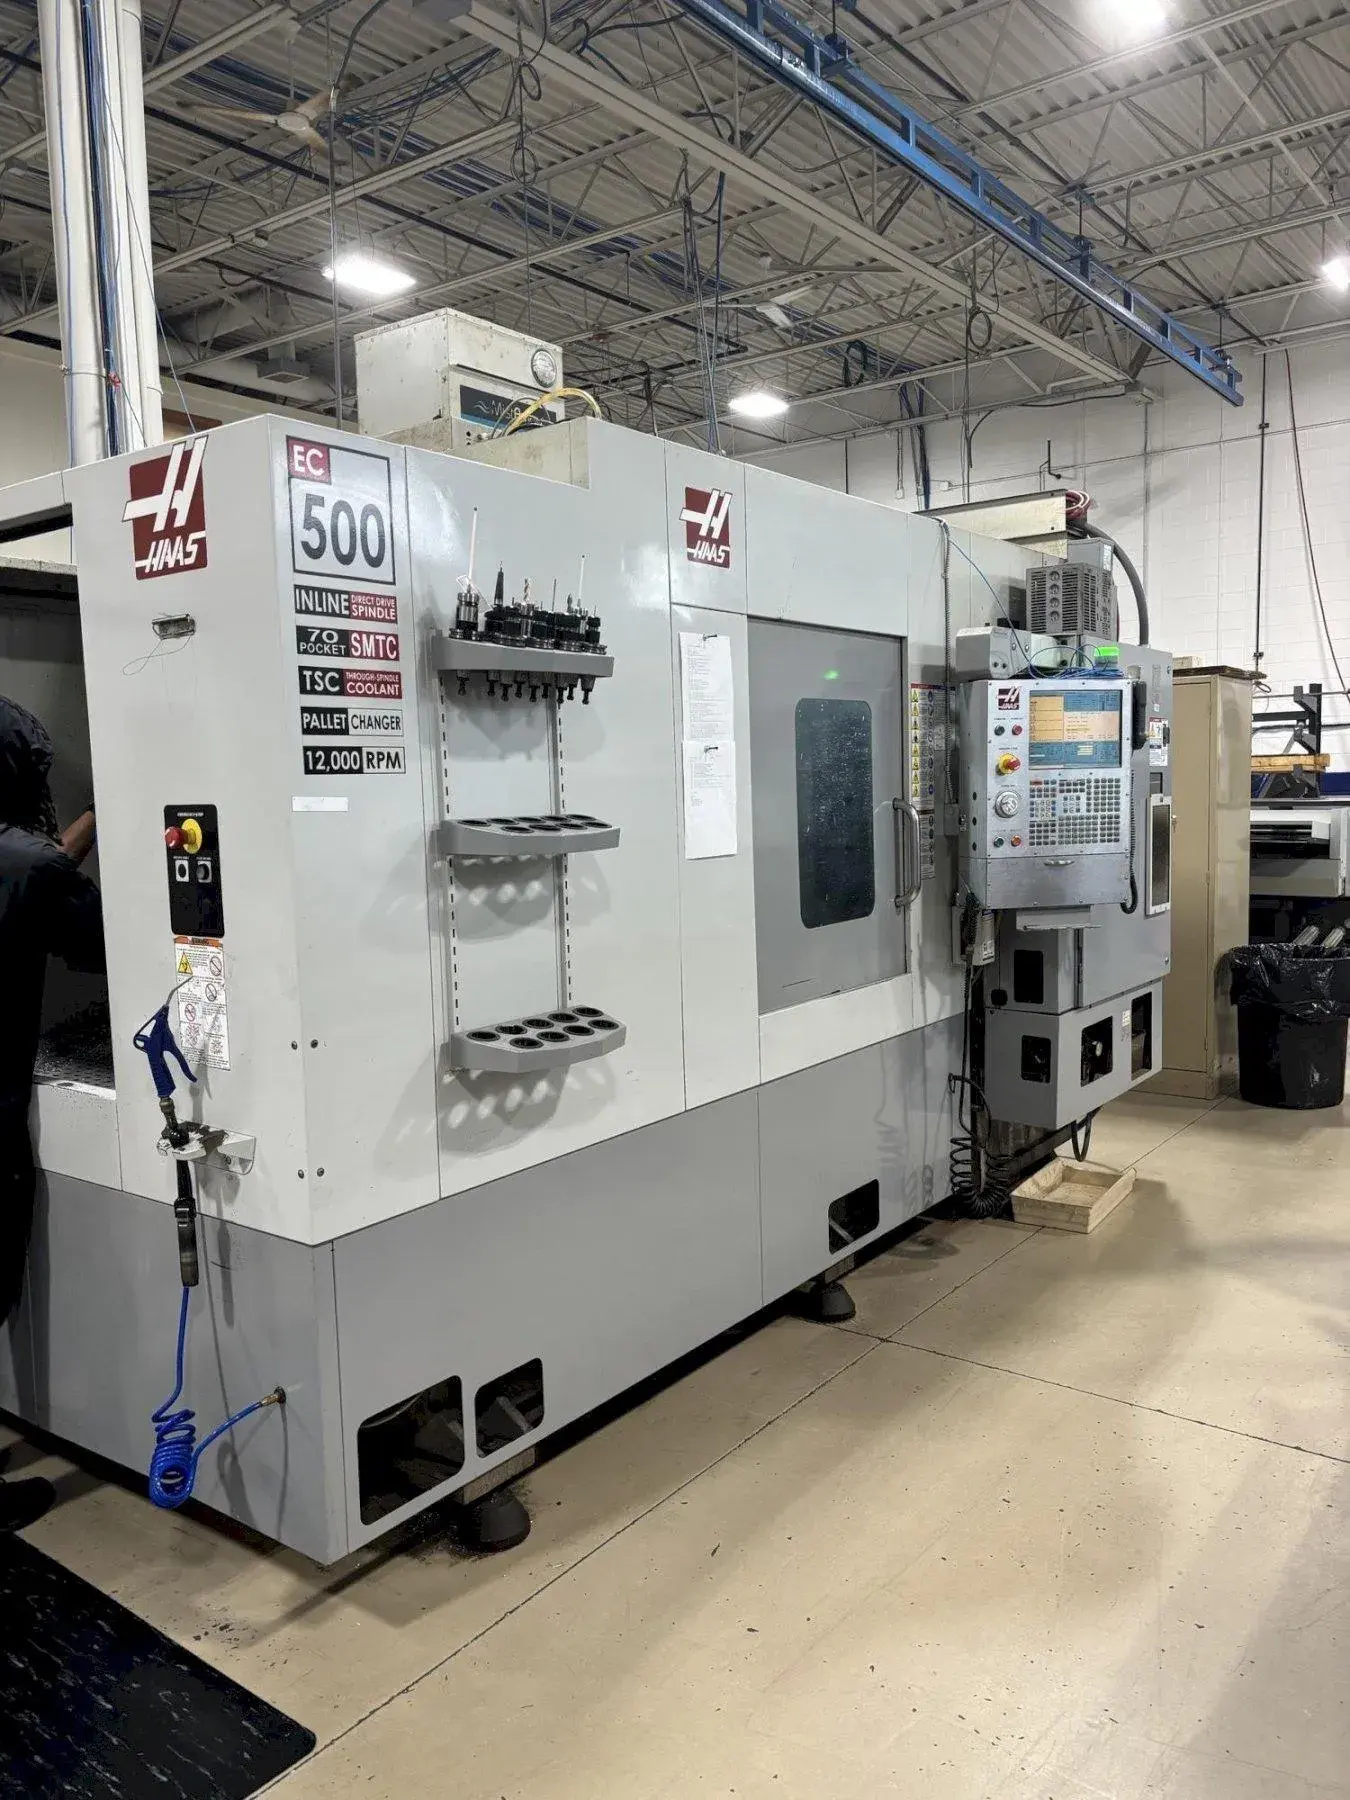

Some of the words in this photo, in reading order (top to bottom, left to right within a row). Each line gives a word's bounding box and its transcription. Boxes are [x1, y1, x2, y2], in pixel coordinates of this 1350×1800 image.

[292, 444, 325, 476] EC
[301, 493, 386, 569] 500
[135, 530, 206, 573] HAAS
[687, 540, 731, 564] HAAS
[295, 588, 350, 615] INLINE
[351, 594, 375, 605] DIRECT
[375, 597, 396, 608] DRIVE
[352, 604, 396, 620] SPINDLE
[307, 629, 339, 643] 70
[351, 632, 397, 659] SMTC
[300, 642, 346, 655] POCKET
[303, 670, 340, 692] TSC
[346, 671, 399, 682] THROUGH-SPINDLE
[346, 682, 399, 695] COOLANT
[302, 713, 347, 730] PALLET
[351, 714, 402, 730] CHANGER
[306, 750, 361, 772] 12,000
[366, 751, 402, 769] RPM
